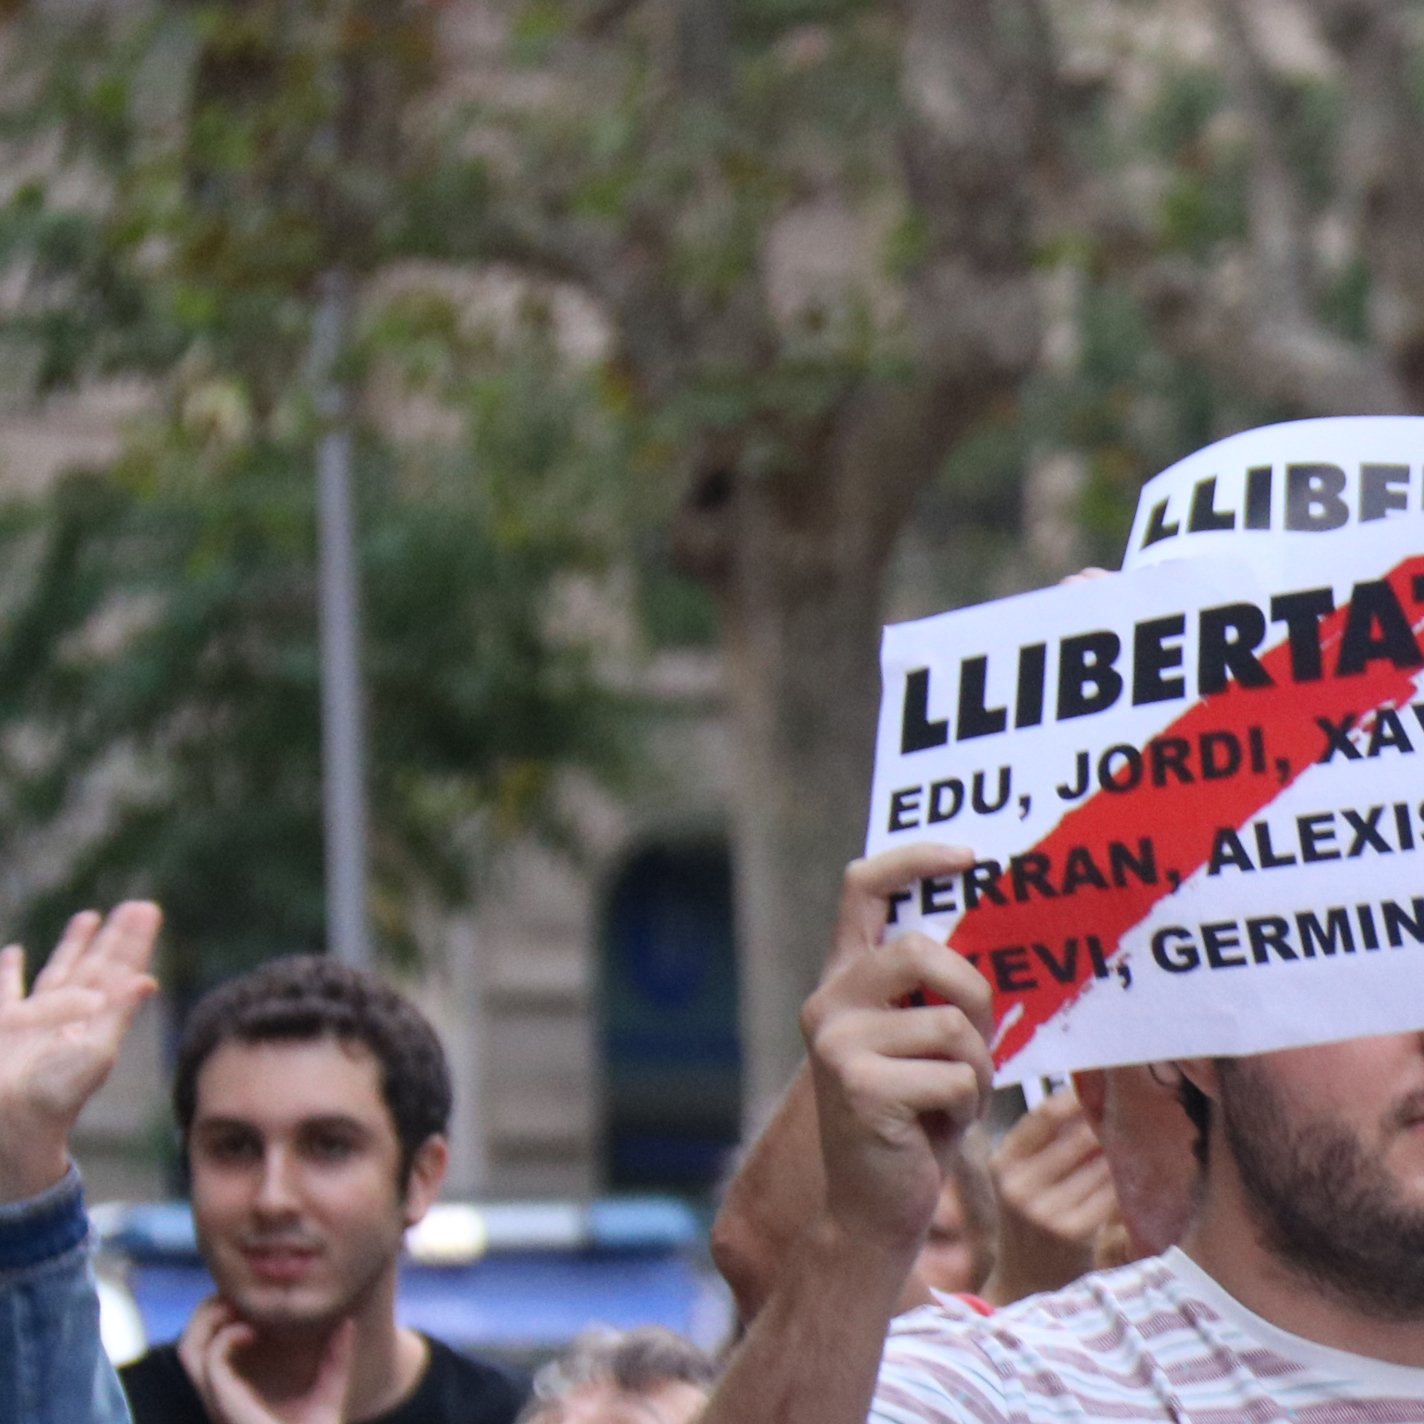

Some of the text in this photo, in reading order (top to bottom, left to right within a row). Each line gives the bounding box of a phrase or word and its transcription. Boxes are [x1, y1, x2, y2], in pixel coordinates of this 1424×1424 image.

[887, 765, 1031, 832] EDU,
[1057, 725, 1289, 802] JORDI,
[886, 835, 1180, 923] FERRAN,
[958, 934, 1132, 993] EVI,
